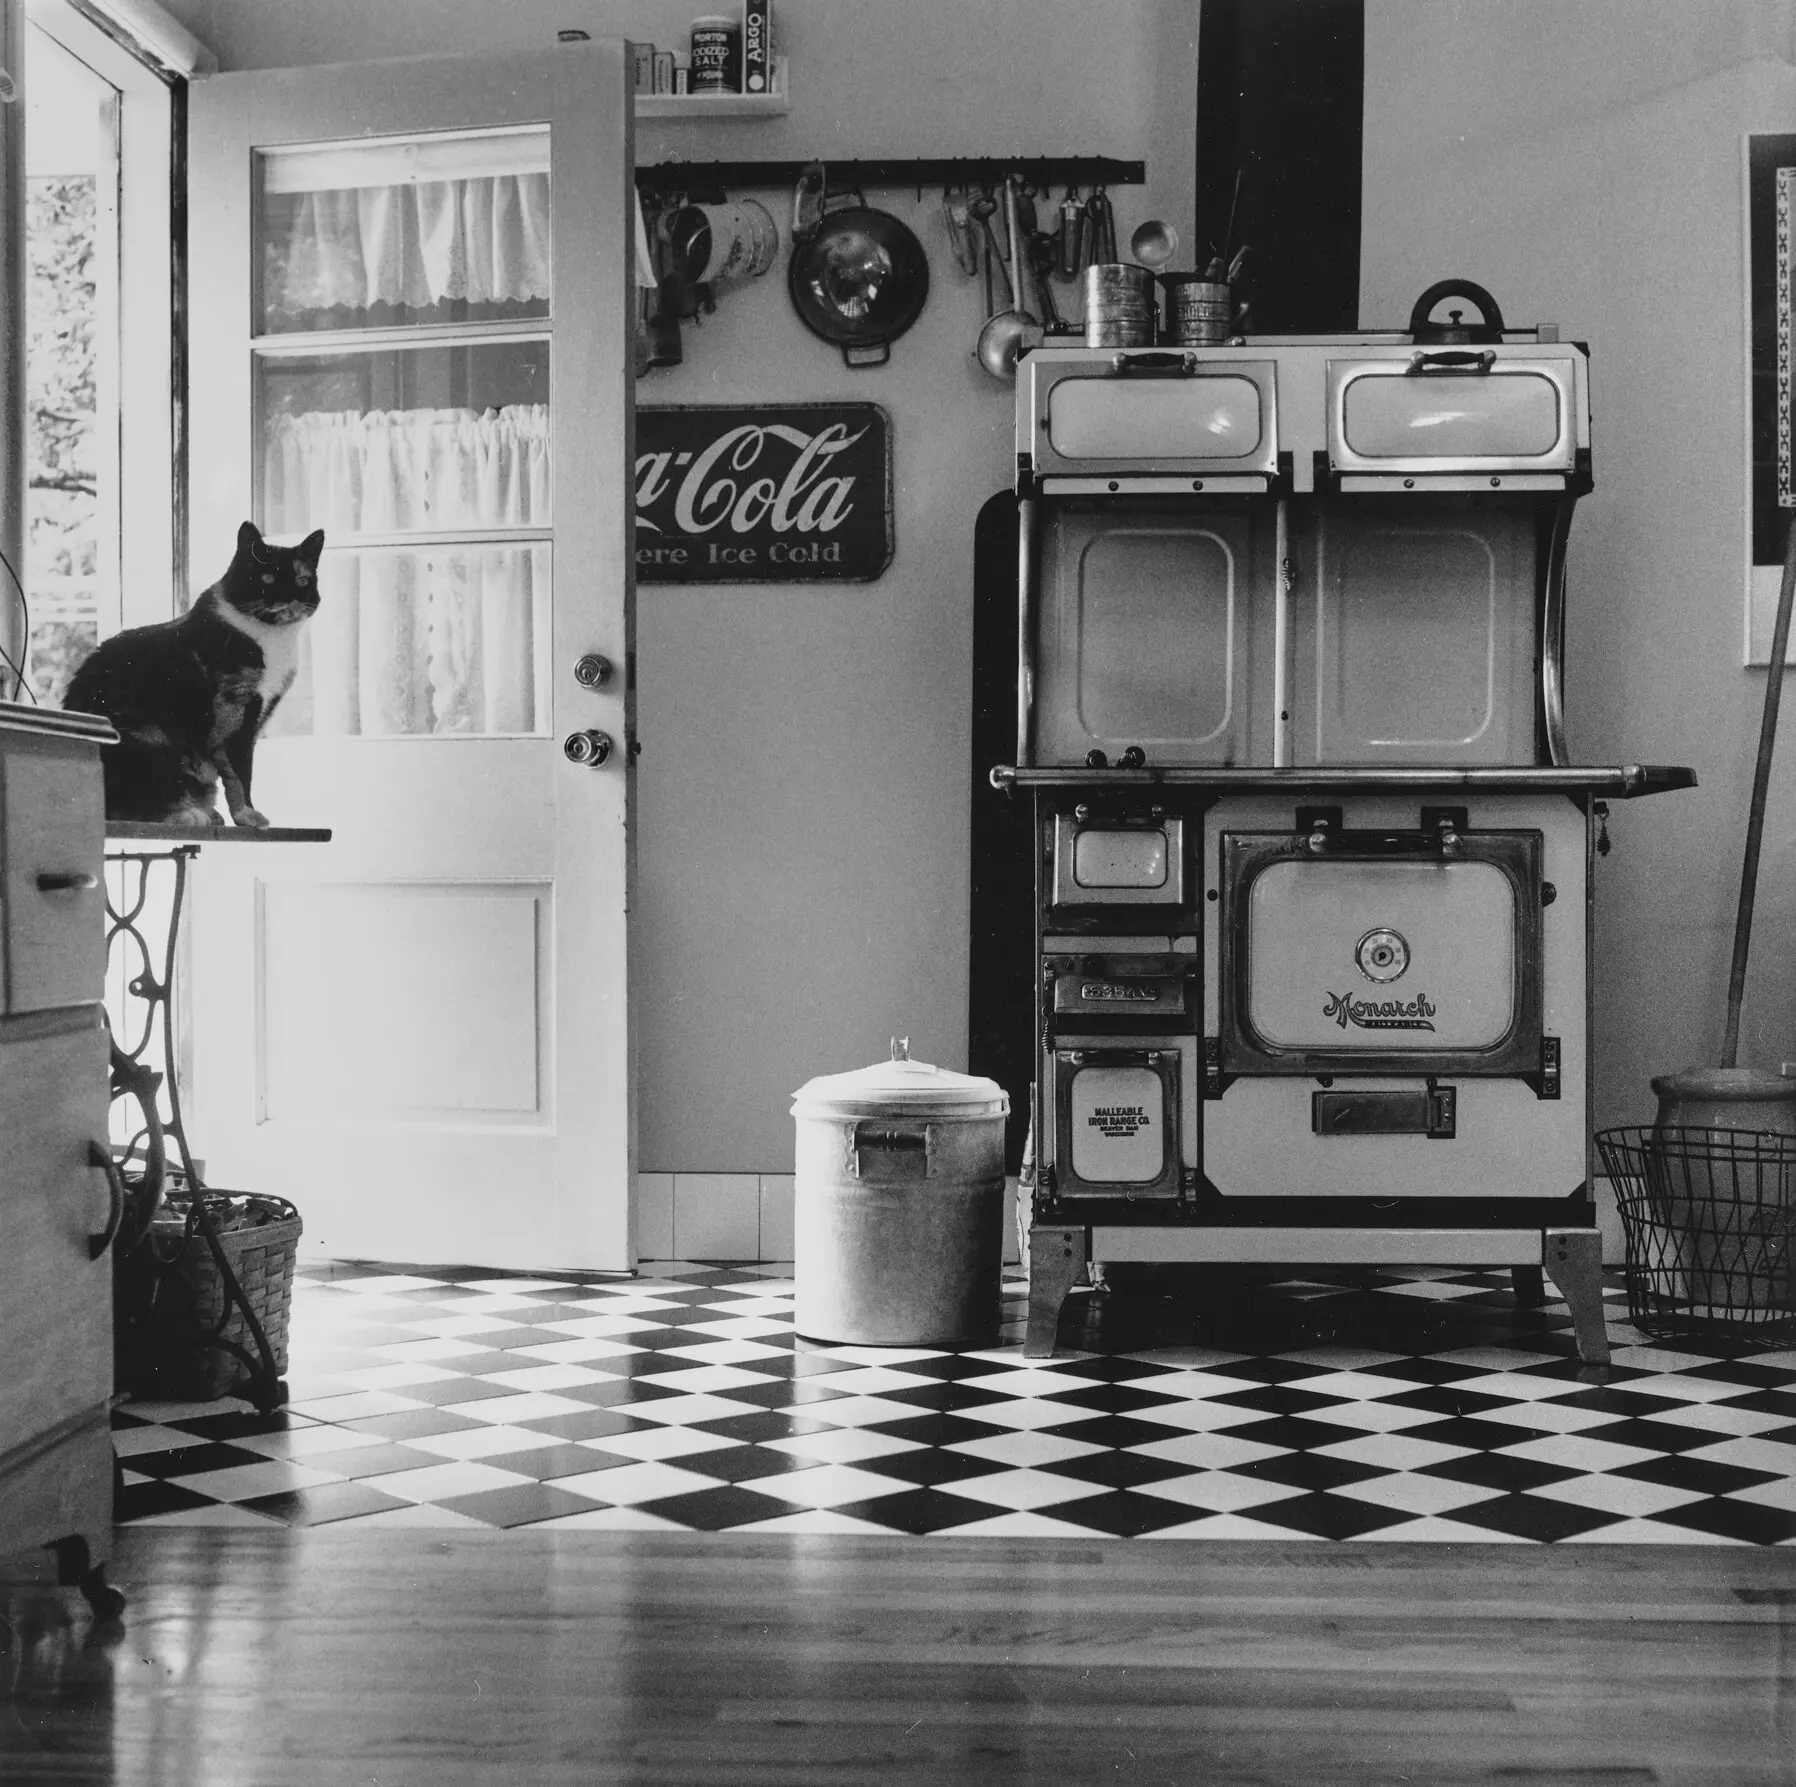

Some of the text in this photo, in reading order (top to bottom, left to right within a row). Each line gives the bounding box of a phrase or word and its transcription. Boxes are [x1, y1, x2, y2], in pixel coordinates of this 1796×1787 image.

[694, 32, 728, 42] MORTON
[747, 12, 762, 63] ARGO
[695, 55, 725, 66] SALT
[707, 542, 758, 564] Ice
[768, 541, 843, 563] Cold
[1322, 990, 1437, 1031] Monarch
[1094, 1106, 1144, 1117] MALLEABLE
[1088, 1116, 1108, 1126] IRON
[1109, 1116, 1137, 1126] RANGE
